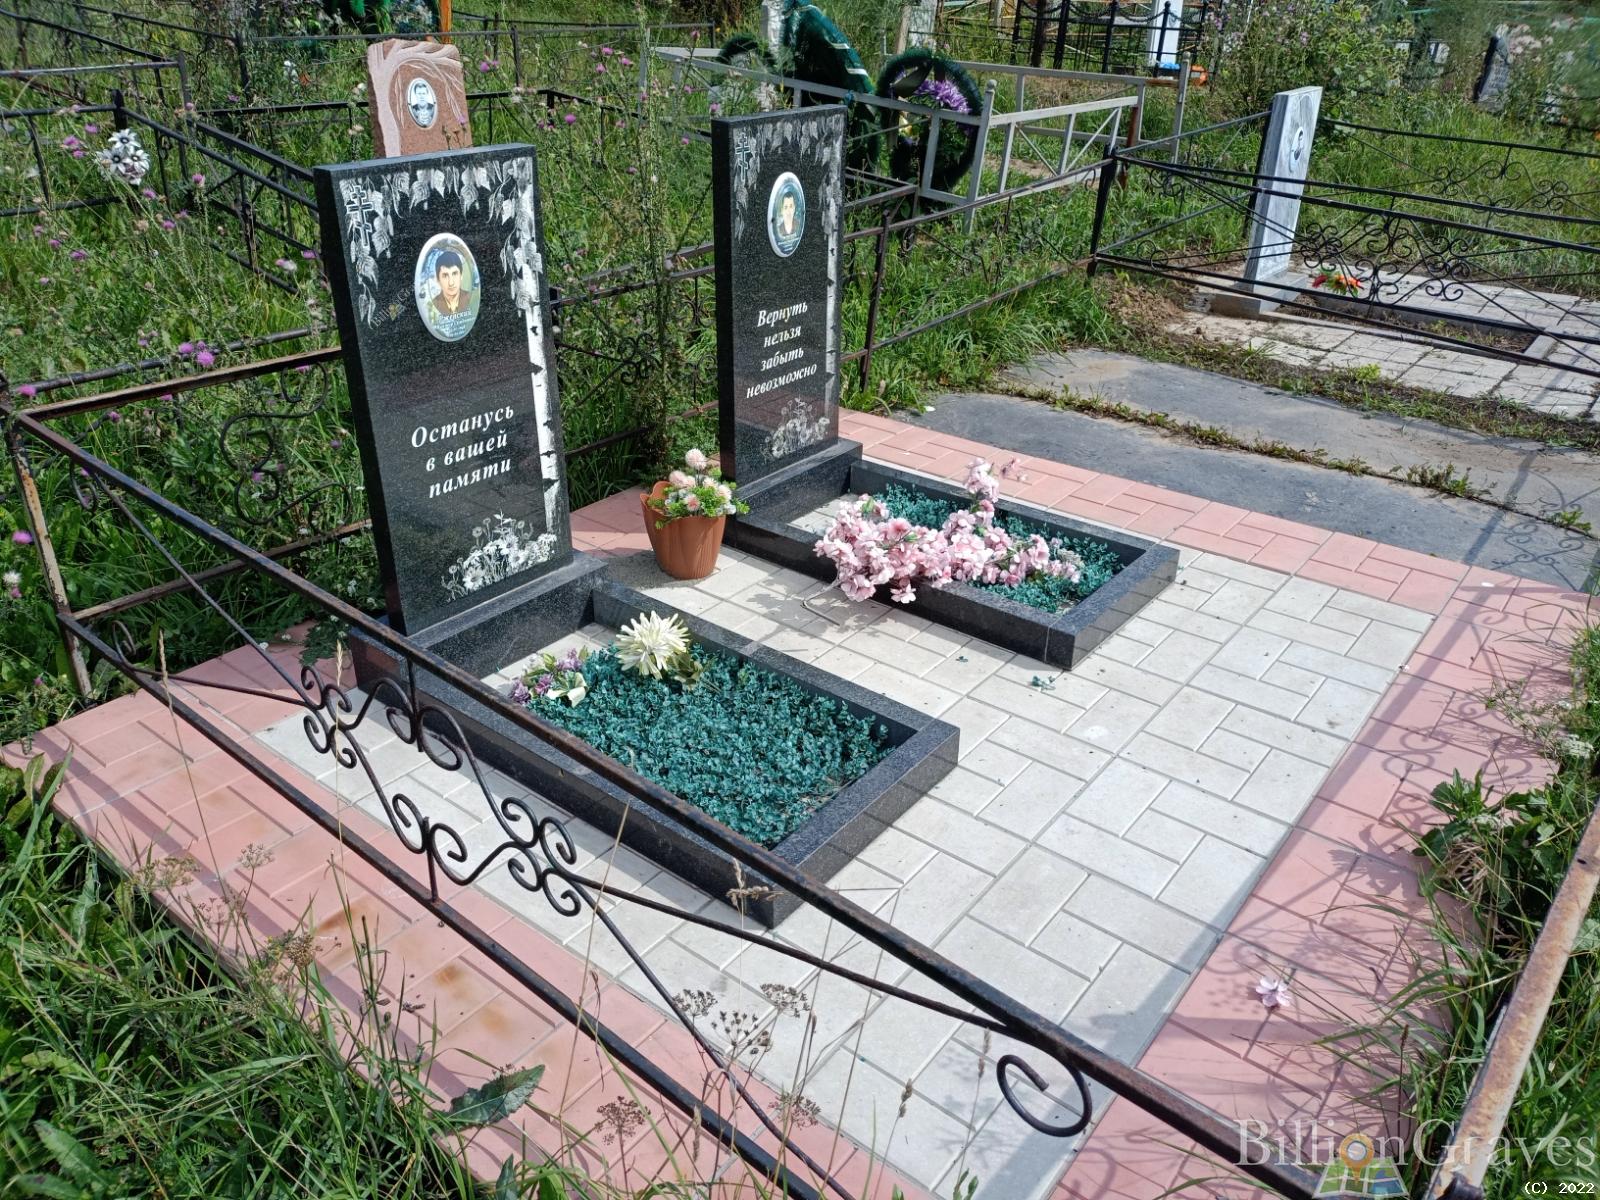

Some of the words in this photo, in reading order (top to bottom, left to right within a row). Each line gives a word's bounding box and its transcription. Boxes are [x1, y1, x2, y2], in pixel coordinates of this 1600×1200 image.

[757, 301, 808, 328] Вернуть
[763, 325, 802, 348] нельзя
[760, 347, 804, 372] забыть
[746, 363, 818, 399] невозможно
[411, 405, 514, 448] Останусь
[425, 457, 436, 472] в
[443, 428, 508, 466] вашей
[429, 458, 511, 499] памяти
